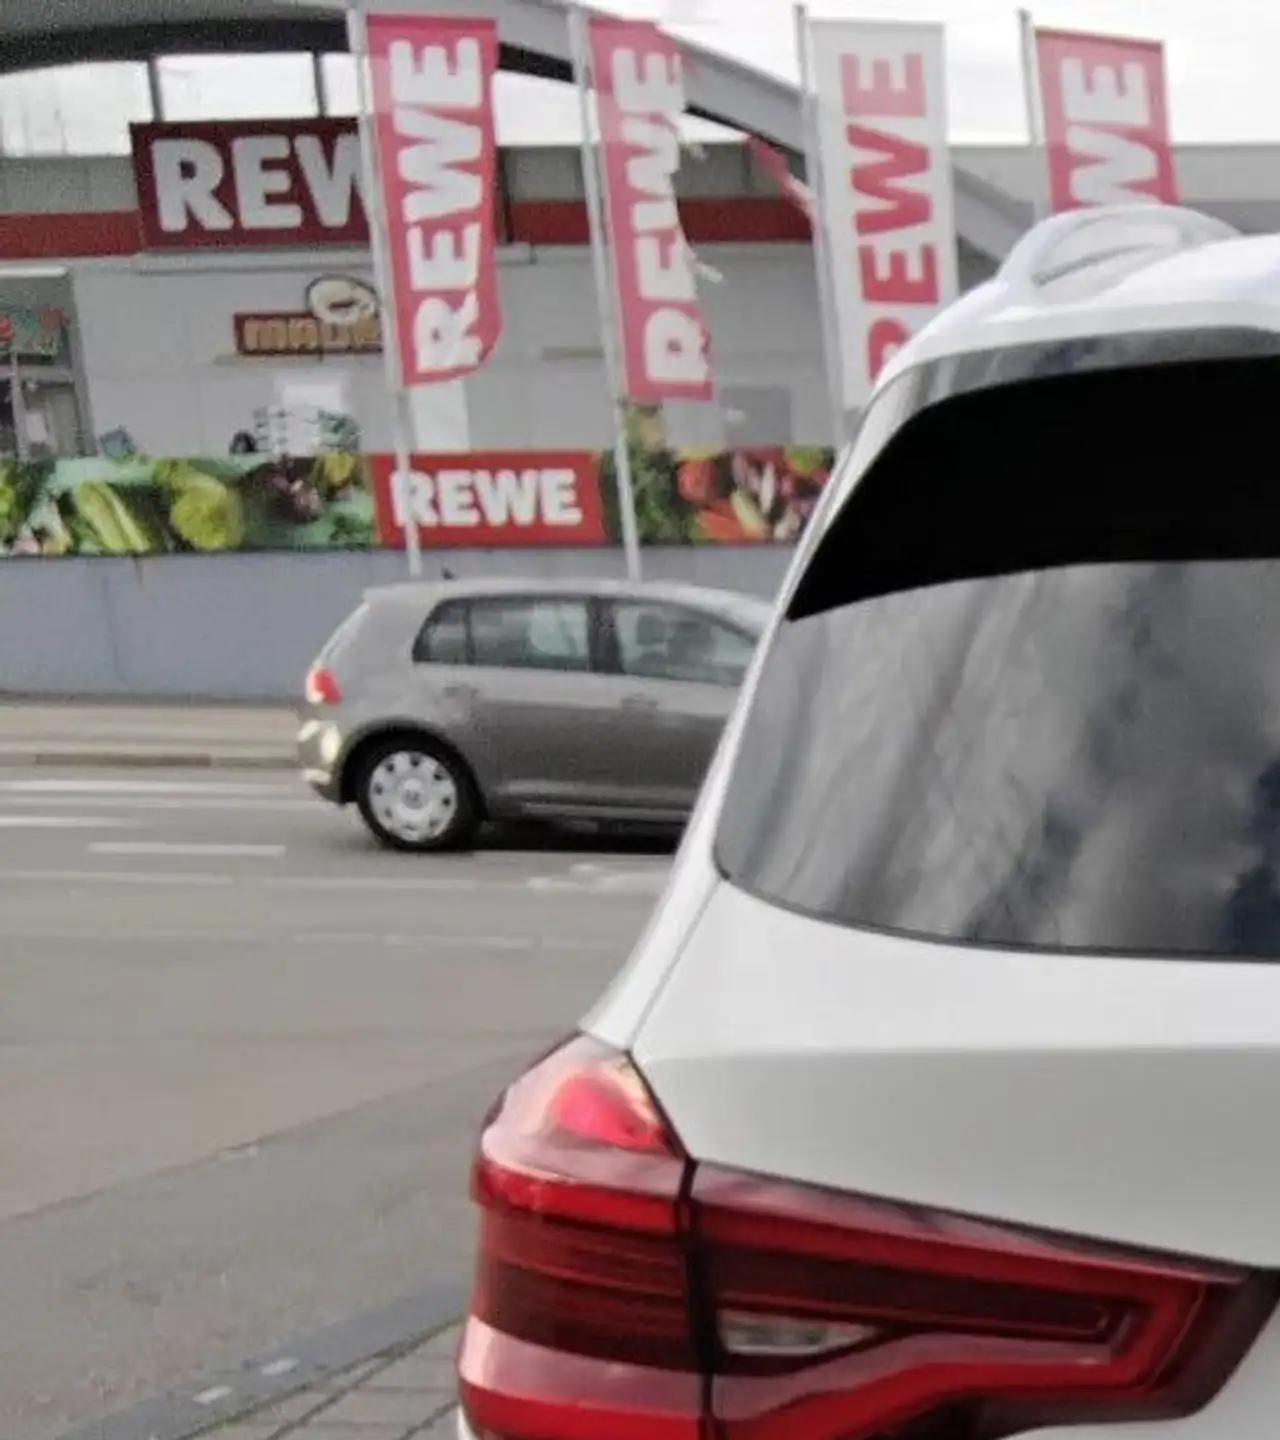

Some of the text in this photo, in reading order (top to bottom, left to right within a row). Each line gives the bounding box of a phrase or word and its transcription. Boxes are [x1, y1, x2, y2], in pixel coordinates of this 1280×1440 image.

[152, 133, 363, 232] REW
[1060, 58, 1161, 207] WE
[390, 37, 483, 373] REWE
[389, 469, 583, 527] REWE
